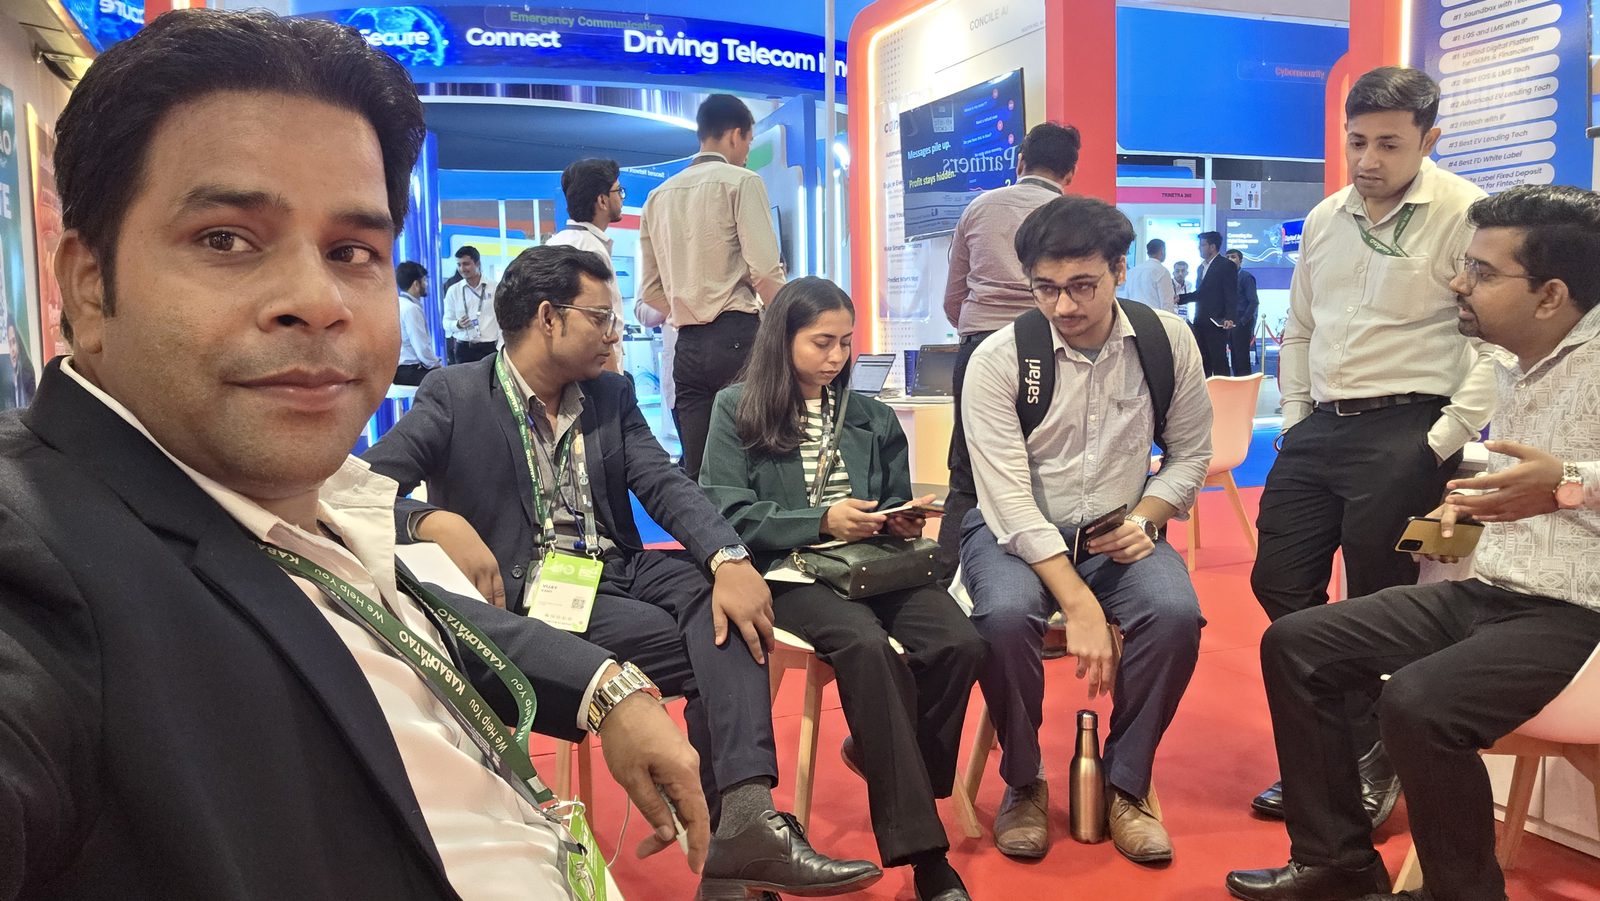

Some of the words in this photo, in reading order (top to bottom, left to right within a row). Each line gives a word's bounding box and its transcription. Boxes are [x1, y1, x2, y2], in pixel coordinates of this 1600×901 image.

[970, 8, 1000, 31] CONCILE
[1464, 4, 1496, 18] Soundbox
[510, 11, 574, 28] Emergency
[577, 15, 665, 31] Communication
[1476, 28, 1489, 36] and
[1490, 24, 1504, 32] LMS
[1505, 20, 1520, 28] with
[465, 27, 562, 48] Connect
[624, 30, 718, 64] Driving
[722, 38, 816, 72] Telecom
[1486, 43, 1508, 52] Digital
[1509, 35, 1539, 48] Platform
[1513, 65, 1530, 73] Tech
[1460, 95, 1494, 107] Advanced
[1504, 86, 1532, 98] Lending
[1534, 83, 1551, 92] Tech
[1459, 118, 1483, 128] Fintech
[1484, 114, 1498, 122] with
[1459, 138, 1473, 147] Best
[1474, 136, 1482, 144] EV
[1483, 133, 1510, 143] Lending
[1511, 129, 1528, 138] Tech
[908, 147, 931, 160] Messages
[932, 142, 941, 154] pile
[942, 141, 951, 151] up.
[1448, 160, 1458, 168] #4
[1459, 158, 1473, 167] Best
[1483, 153, 1503, 162] White
[1503, 150, 1523, 160] Label
[909, 177, 922, 188] Profit
[923, 175, 936, 185] stays
[936, 168, 956, 181] hidden.
[1477, 174, 1495, 183] Label
[1496, 171, 1514, 180] Fixed
[1515, 168, 1542, 178] Deposit
[1496, 178, 1525, 188] Fintechs
[1025, 359, 1040, 404] safari
[315, 568, 337, 587] You
[340, 584, 364, 607] Help
[366, 604, 384, 624] We
[510, 678, 527, 698] You
[469, 699, 483, 720] You
[482, 715, 499, 740] Help
[495, 735, 508, 753] We
